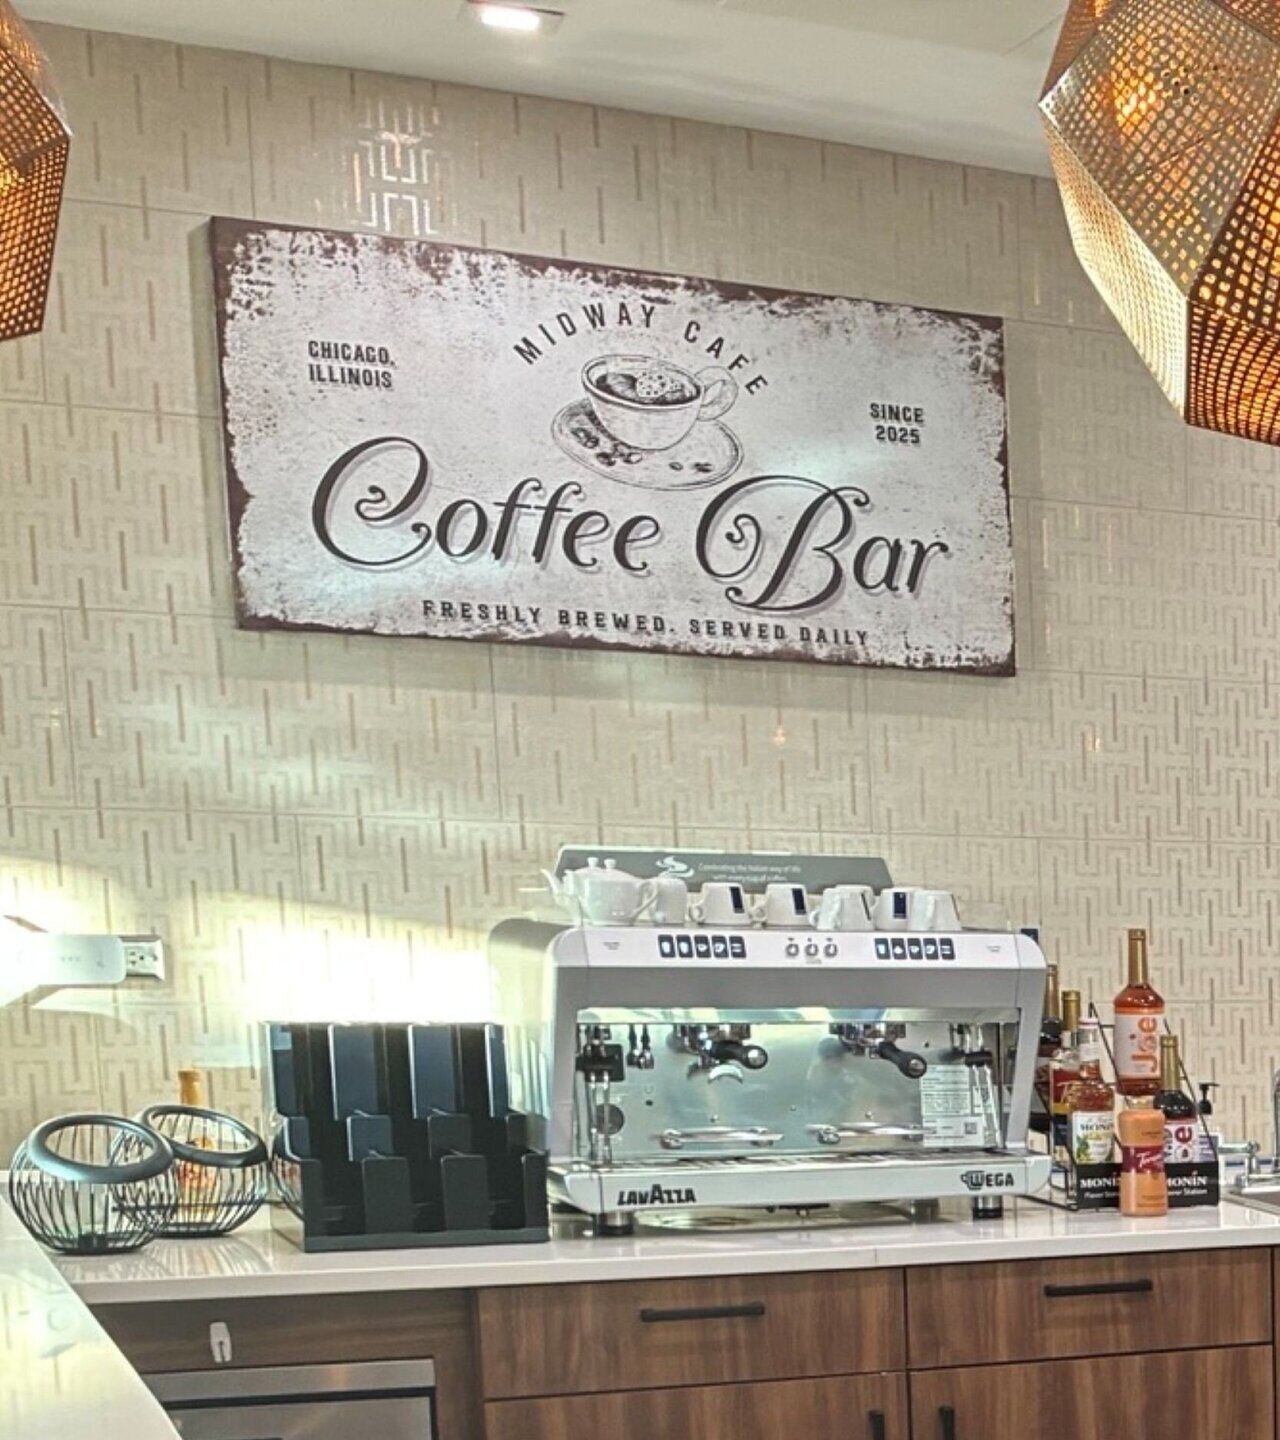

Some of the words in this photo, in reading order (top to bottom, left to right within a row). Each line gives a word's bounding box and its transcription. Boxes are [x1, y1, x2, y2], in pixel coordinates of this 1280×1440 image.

[512, 302, 656, 366] MIDWAY
[684, 319, 769, 397] CAFE
[309, 364, 393, 389] ILLINOIS
[870, 401, 926, 425] SINCE
[875, 424, 922, 446] 2025
[310, 435, 662, 570] Coffee
[695, 473, 948, 612] Bar
[423, 600, 541, 626] FRESHLY
[689, 620, 785, 641] SERVED
[800, 628, 869, 647] DAILY
[1080, 1172, 1120, 1188] MONI
[618, 1184, 696, 1205] LAVAZZA
